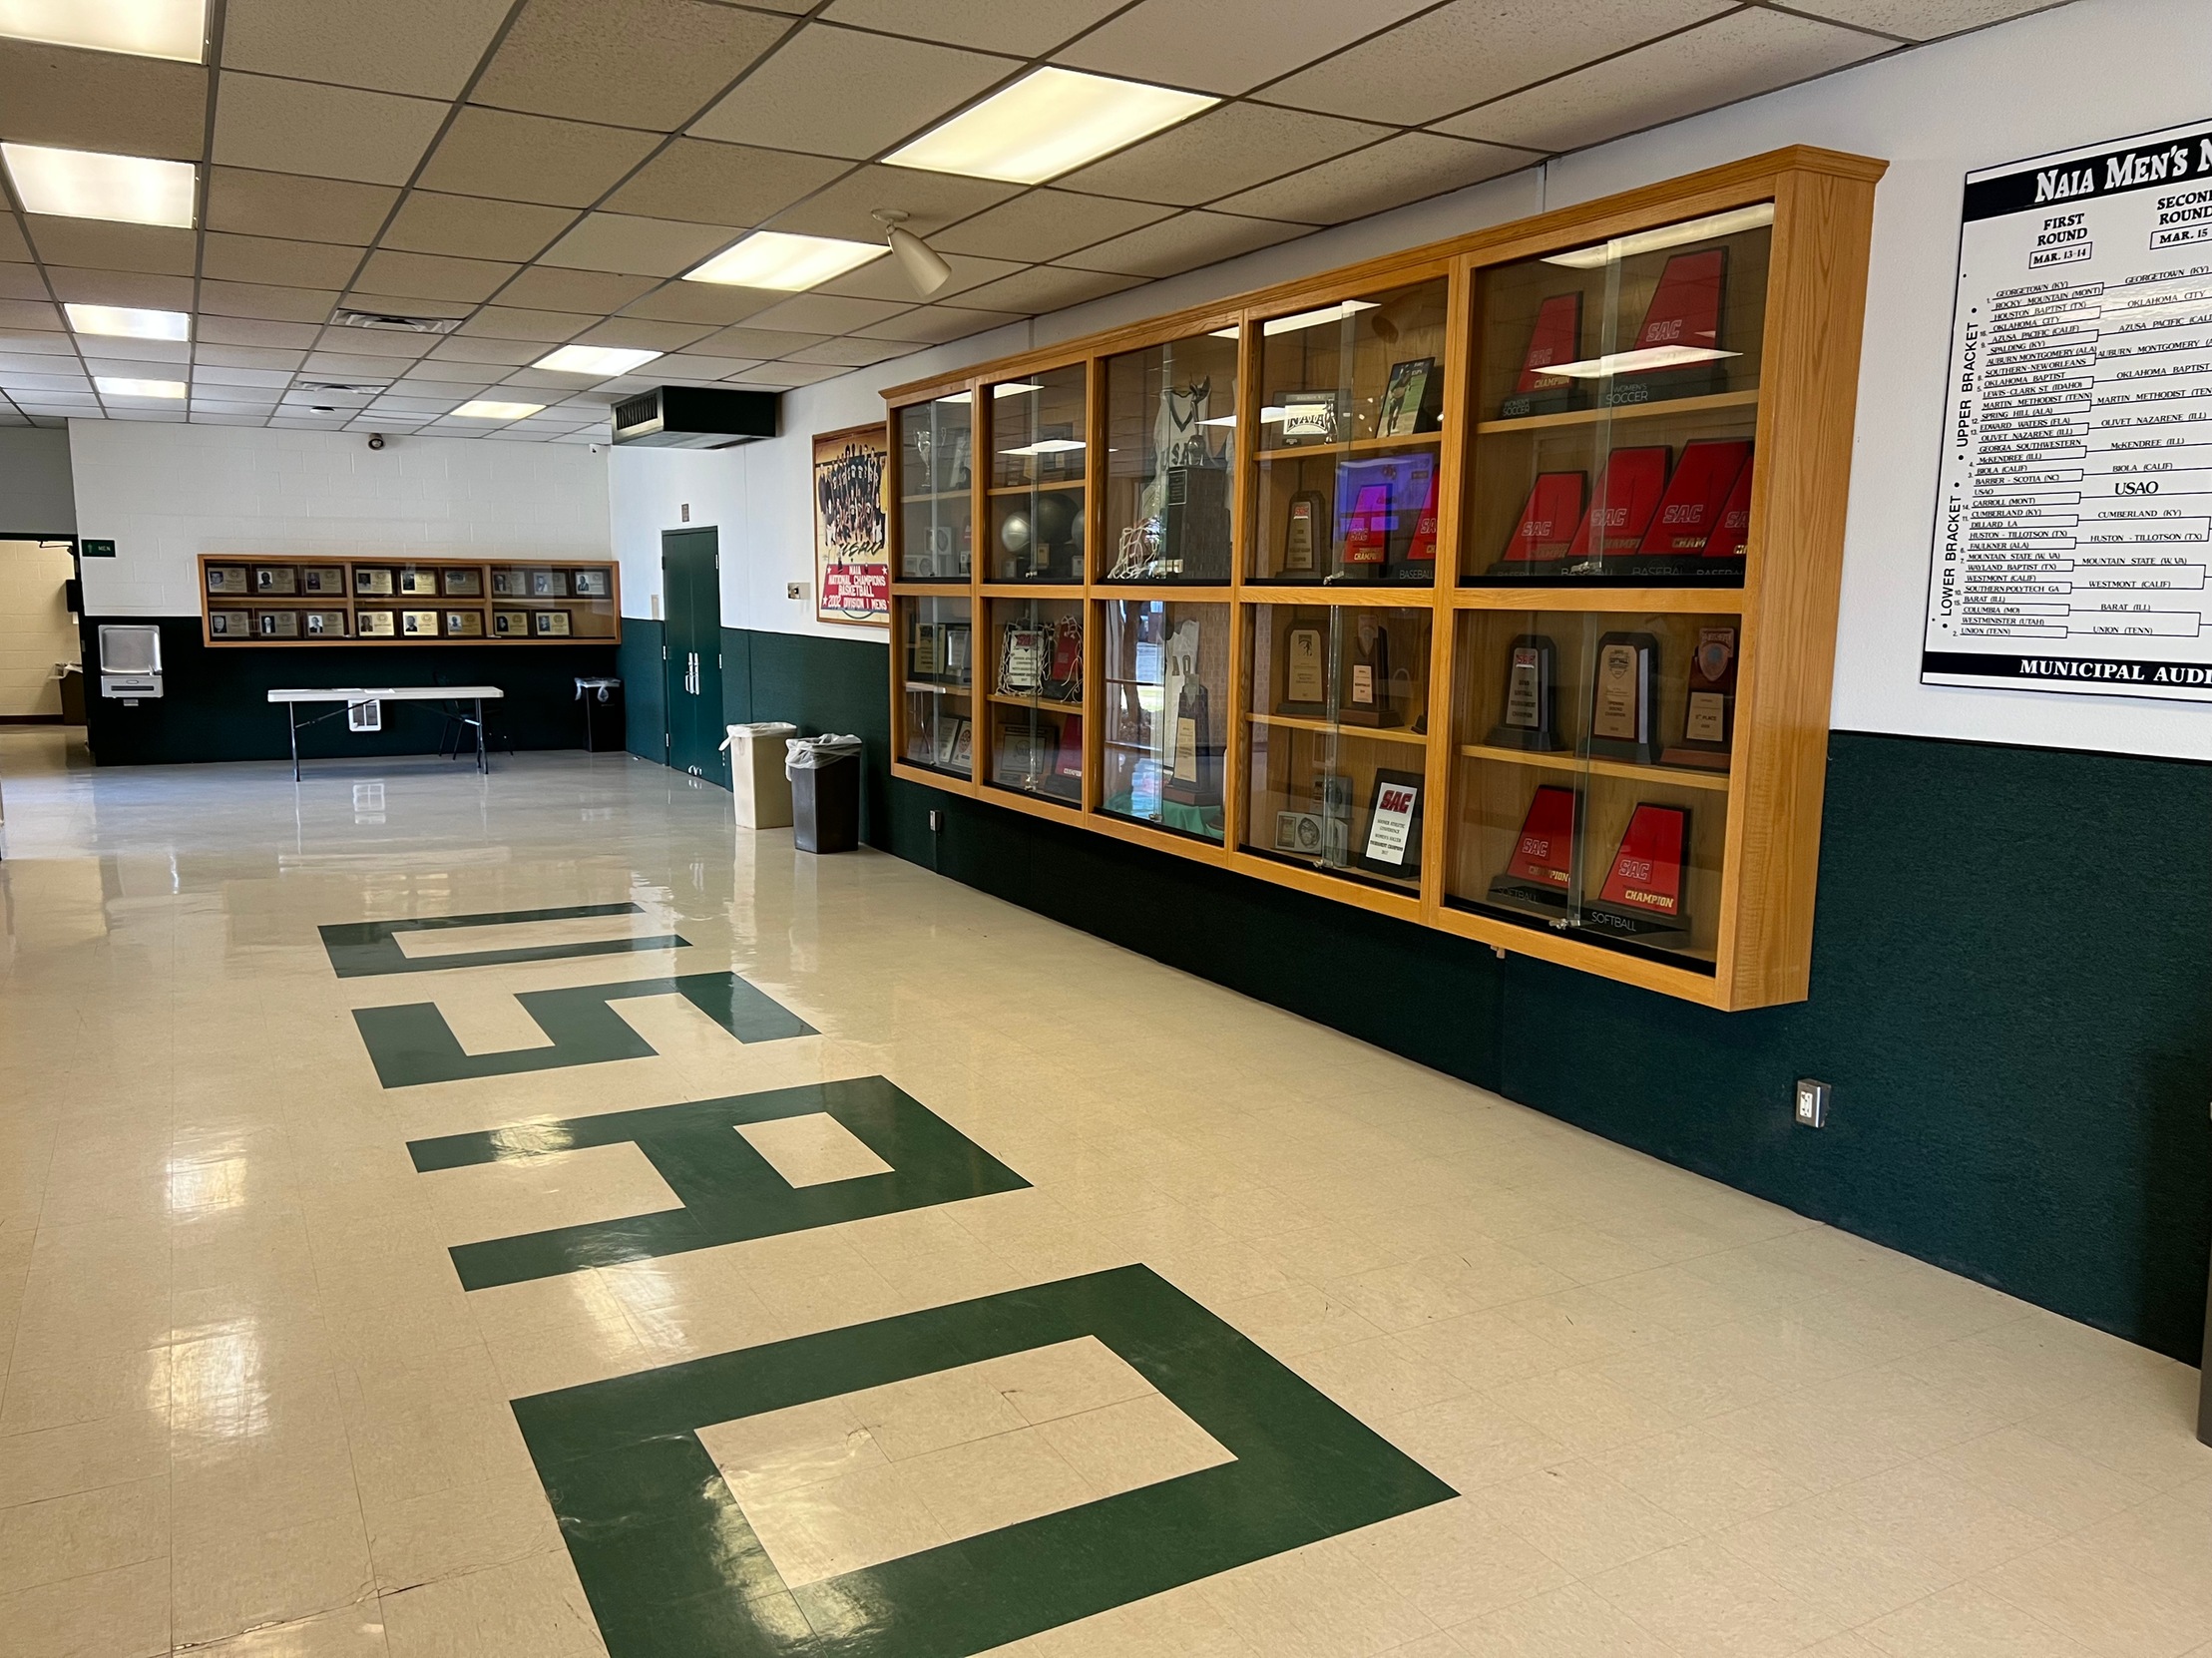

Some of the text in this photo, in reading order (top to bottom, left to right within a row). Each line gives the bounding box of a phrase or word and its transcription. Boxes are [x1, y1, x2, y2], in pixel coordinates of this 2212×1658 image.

[2043, 213, 2084, 230] FIRST
[2159, 206, 2212, 225] ROUND
[2037, 228, 2087, 246] ROUND
[2160, 228, 2208, 243] MAR. 15
[2033, 248, 2086, 264] MAR. 13-14
[2125, 266, 2209, 283] GEORGETOWN (KY)
[1996, 281, 2068, 297] GEORGETOWN (KY)
[1996, 287, 2100, 308] ROCKY MOUNTAIN (MONT)
[2128, 290, 2205, 306] OKLAHOMA CITY
[1994, 301, 2086, 321] HOUSTON BAPTIST (TX)
[1646, 319, 1682, 342] SAC
[1993, 319, 2036, 331] OKLAHOMA
[2119, 318, 2184, 332] AZUSA PACIFIC
[1992, 324, 2079, 343] AZUSA PACIFIC (CALIF)
[1991, 340, 2044, 353] SPALDING (KY)
[2098, 340, 2200, 357] AUBURN MONTGOMERY
[1988, 355, 2017, 365] AUBURN
[2019, 348, 2074, 361] MONTGOMERY
[2117, 363, 2210, 378] OKLAHOMA BAPTIST
[1957, 322, 1979, 447] UPPER BRACKET
[1985, 372, 2065, 387] OKLAHOMA BAPTIST
[2052, 382, 2082, 391] (IDAHO)
[1606, 391, 1648, 404] SOCCER
[1984, 392, 2092, 409] MARTIN METHODIST (TENN)
[2136, 390, 2186, 400] METHODIST
[1981, 422, 2011, 431] EDWARD
[2018, 419, 2047, 428] WATERS
[2137, 414, 2183, 424] NAZARENE
[2013, 430, 2053, 439] NAZARENE
[1980, 439, 2081, 453] GEORGIA SOUTHWESTERN
[2111, 440, 2162, 449] McKENDREE
[2115, 481, 2158, 495] USAO
[1590, 509, 1626, 526] SAC
[1662, 505, 1703, 523] SAC
[1522, 522, 1551, 536] SAC
[1941, 496, 1962, 617] LOWER BRACKET
[828, 575, 886, 586] NATIONAL CHAMPIONS
[838, 585, 874, 597] BASKETBALL
[843, 598, 864, 609] DIVISION
[2019, 659, 2144, 679] MUNICIPAL
[1379, 790, 1413, 814] SAC
[1523, 838, 1548, 857] SAC
[1618, 860, 1649, 880] SAC
[1625, 890, 1674, 908] CHAMPION
[1592, 912, 1636, 932] SOFTBALL
